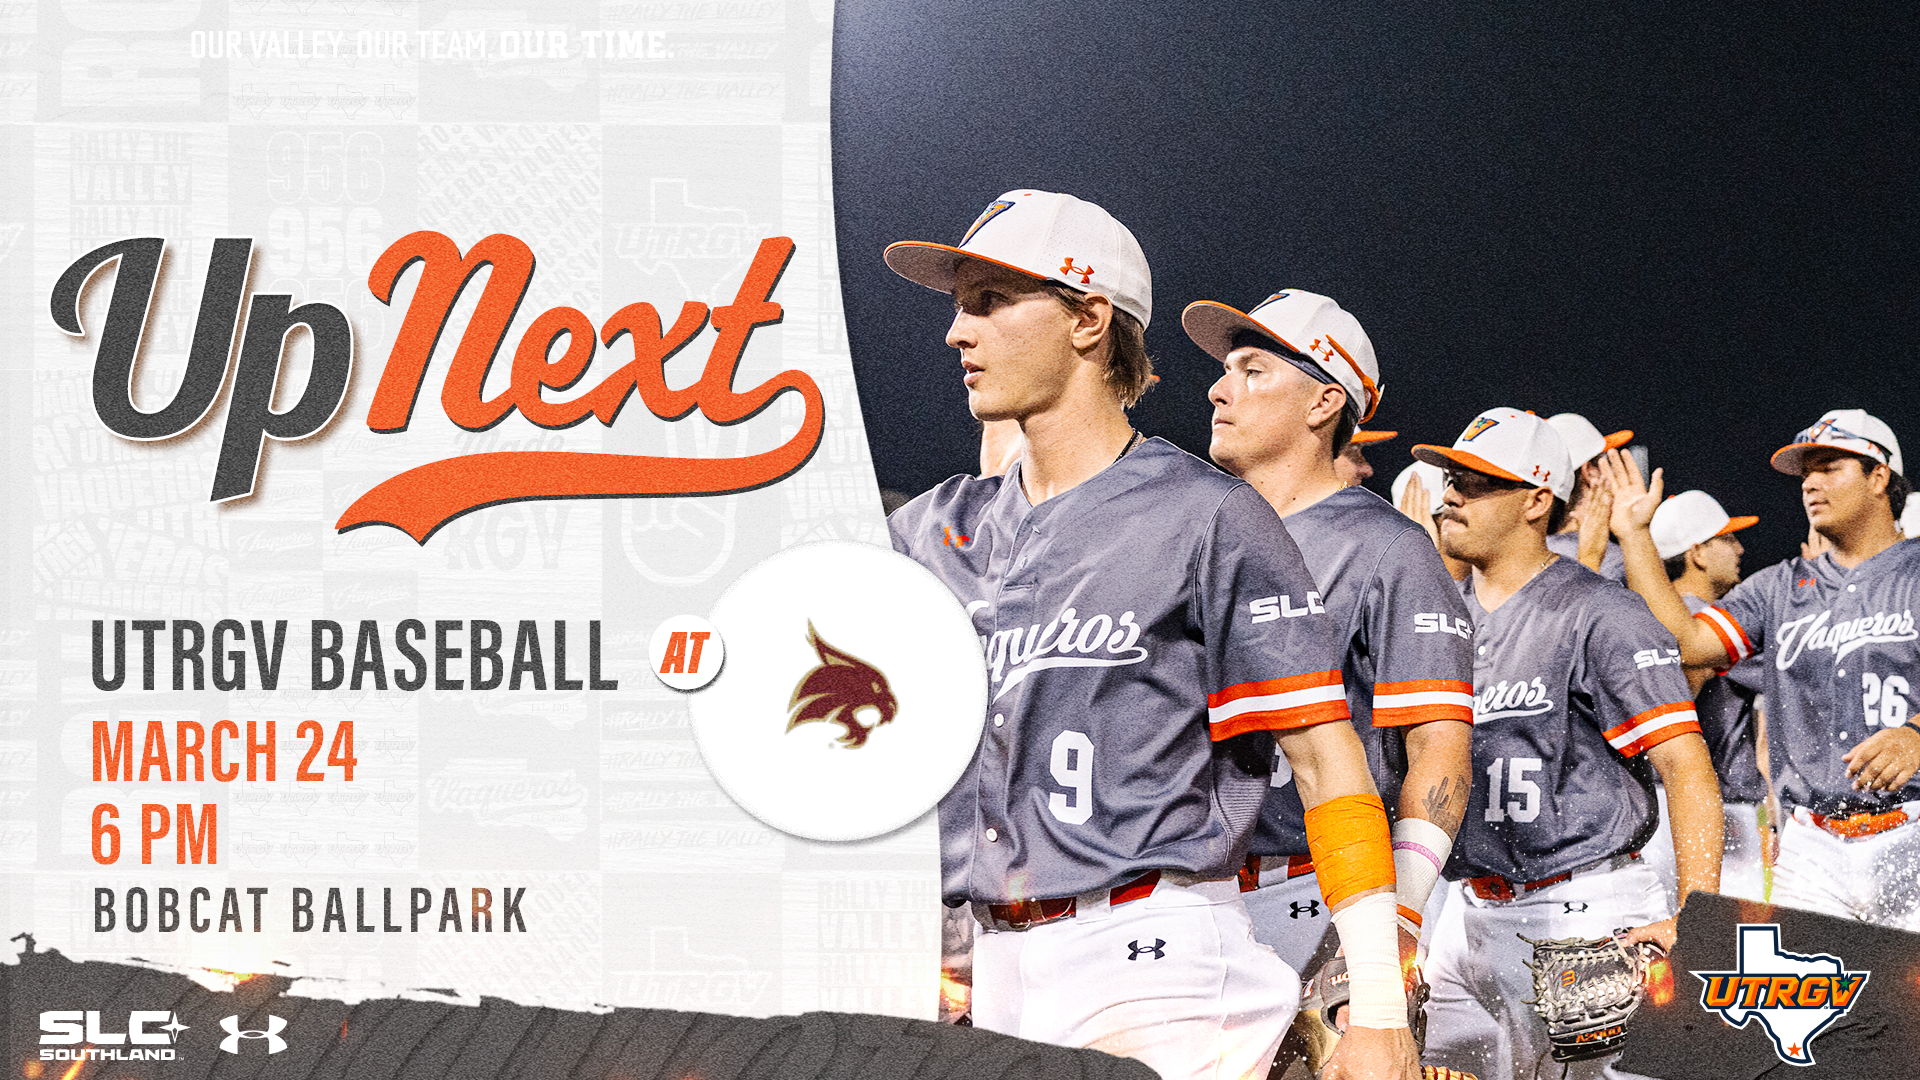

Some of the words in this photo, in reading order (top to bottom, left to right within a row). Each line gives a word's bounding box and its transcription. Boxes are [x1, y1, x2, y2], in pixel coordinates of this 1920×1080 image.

[70, 163, 192, 202] VALLEY
[265, 131, 386, 204] 956
[1414, 613, 1474, 639] SLC
[1776, 610, 1919, 671] Vaqueros
[1862, 672, 1910, 728] 26
[1049, 730, 1095, 826] 9
[1484, 757, 1543, 823] 15
